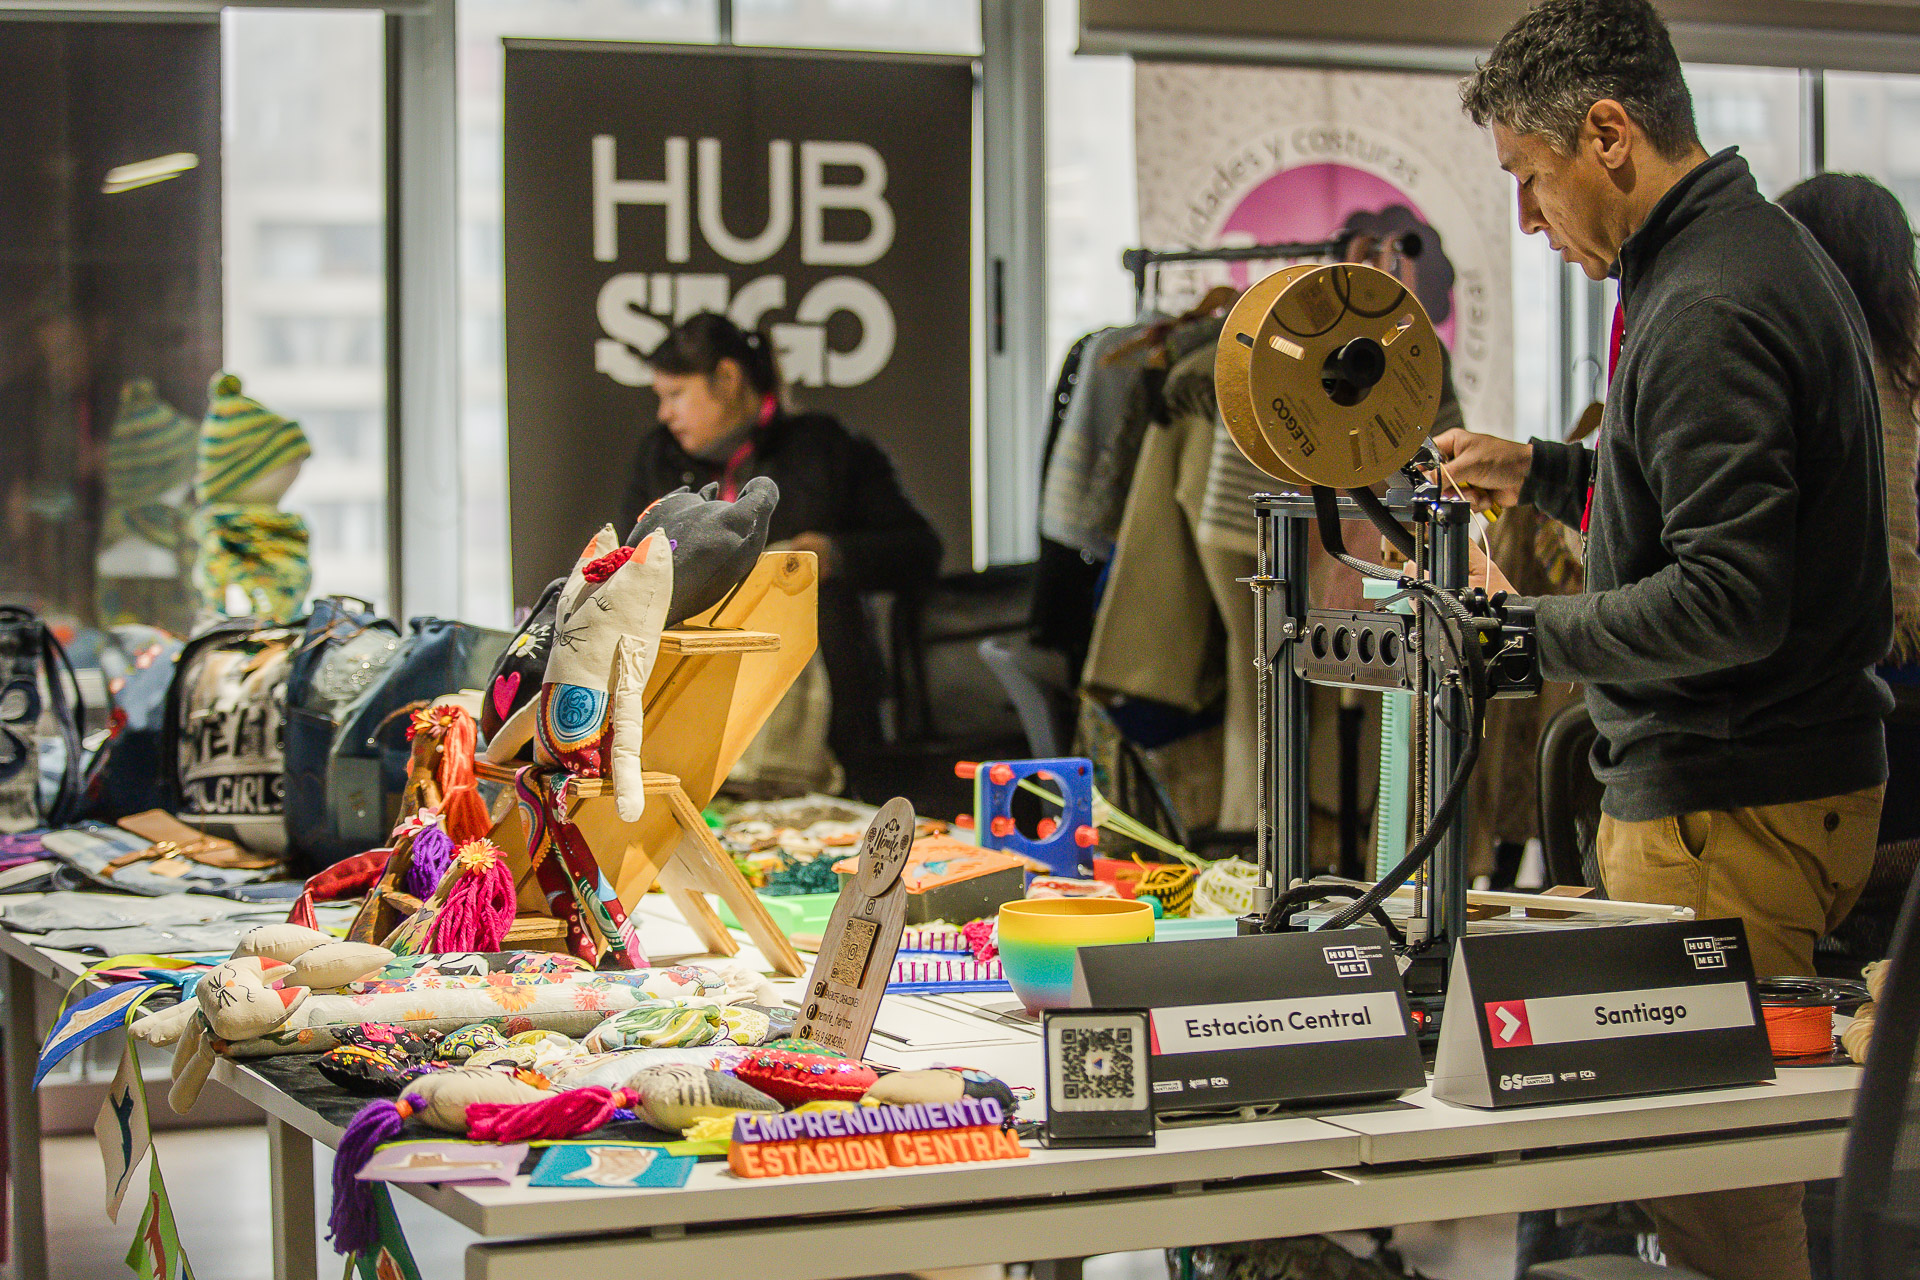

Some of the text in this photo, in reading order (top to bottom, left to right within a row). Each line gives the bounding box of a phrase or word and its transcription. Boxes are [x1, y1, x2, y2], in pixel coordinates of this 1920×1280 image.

[592, 135, 897, 265] HUB
[1272, 397, 1316, 457] ELEGOO
[1328, 950, 1355, 960] HUB
[1688, 941, 1712, 950] HUB
[1339, 963, 1365, 973] MET
[1698, 955, 1721, 964] MET
[1186, 1005, 1372, 1039] Estación Central
[1594, 1002, 1687, 1025] Santiago
[1499, 1074, 1523, 1091] GS
[735, 1097, 1003, 1142] EMPRENDIMIENTO
[738, 1129, 1030, 1178] ESTACION CENTRAL
